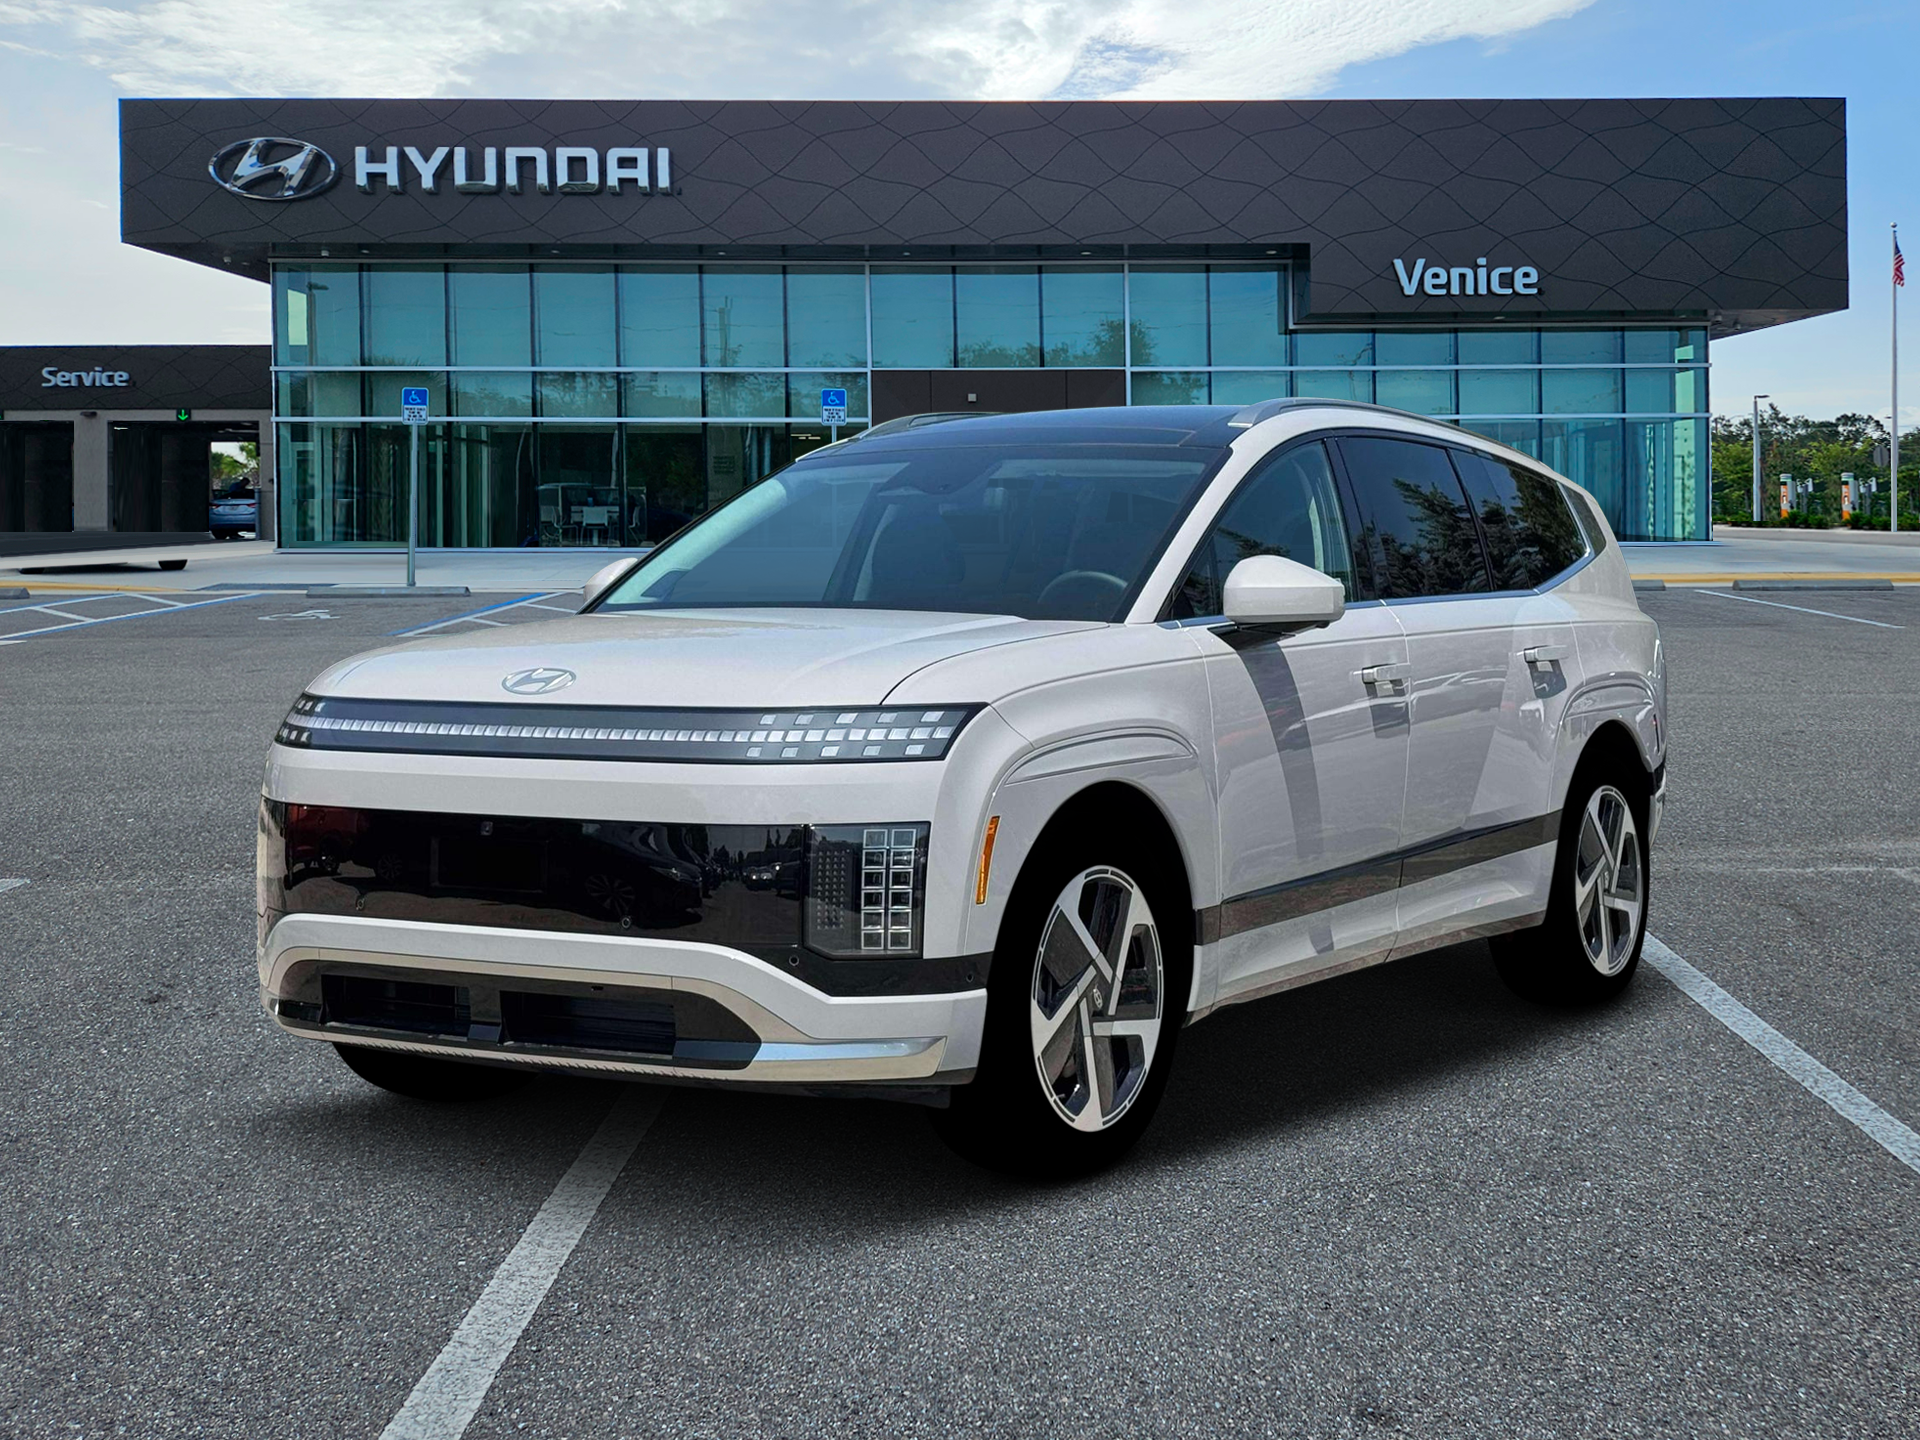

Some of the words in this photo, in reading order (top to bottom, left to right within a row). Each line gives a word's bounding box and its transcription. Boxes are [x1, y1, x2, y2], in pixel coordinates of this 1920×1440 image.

[354, 146, 671, 194] HYUNDAI
[1393, 257, 1539, 295] Venice
[41, 366, 130, 387] Service
